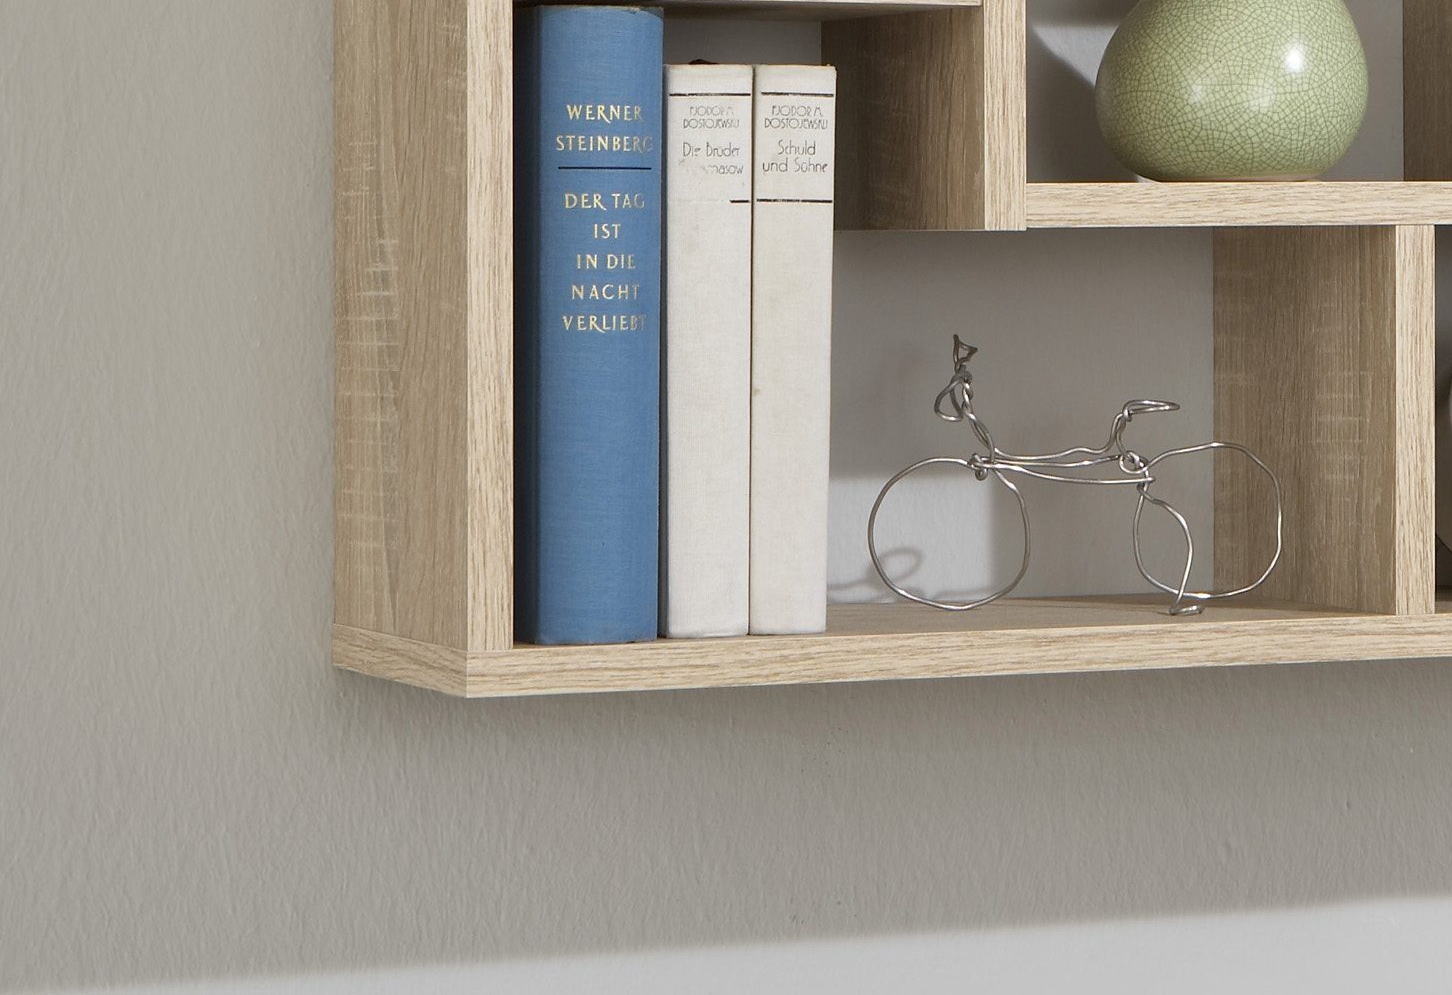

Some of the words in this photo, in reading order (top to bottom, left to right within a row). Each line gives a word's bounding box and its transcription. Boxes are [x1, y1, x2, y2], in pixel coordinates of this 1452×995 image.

[566, 104, 644, 124] WERNER
[556, 135, 653, 154] STEINBERG
[682, 141, 701, 157] Die
[778, 139, 816, 156] Schuld
[762, 157, 788, 173] und
[564, 193, 608, 211] DER
[611, 193, 645, 210] TAG
[594, 223, 621, 239] IST
[576, 254, 598, 270] IN
[607, 254, 636, 270] DIE
[571, 284, 640, 300] NACHT
[562, 315, 647, 333] VERLIEBT
